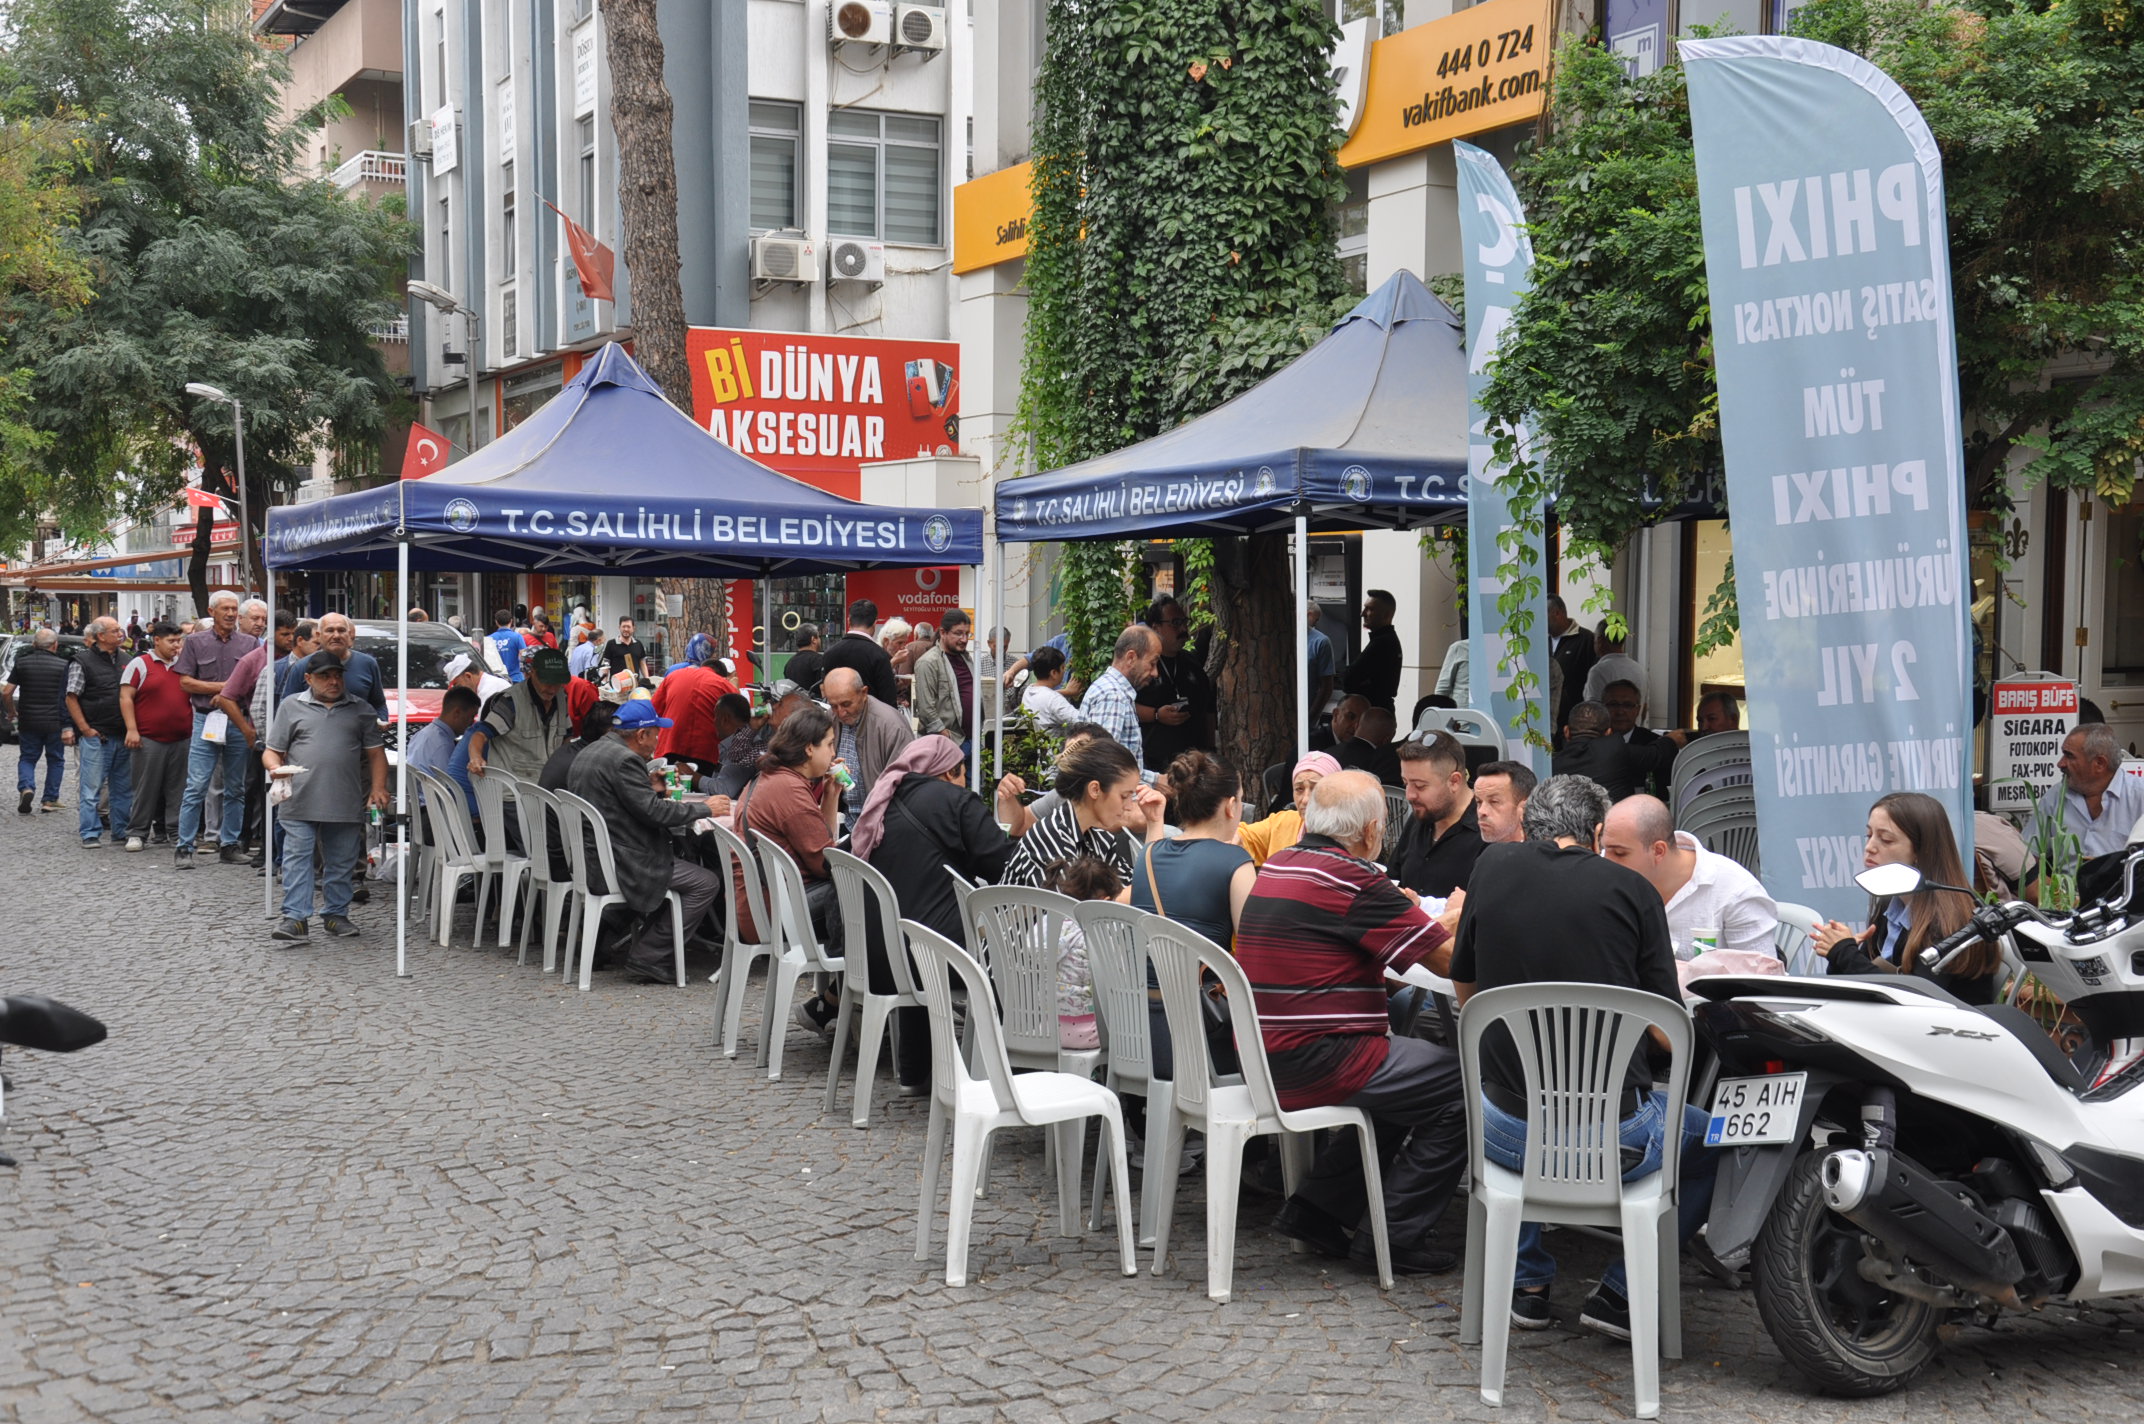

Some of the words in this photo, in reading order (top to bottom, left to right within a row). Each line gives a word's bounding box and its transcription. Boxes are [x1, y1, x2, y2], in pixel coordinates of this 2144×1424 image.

[1437, 45, 1473, 79] 444
[1478, 39, 1490, 68] 0
[1496, 24, 1534, 63] 724
[995, 217, 1026, 246] Salihli
[704, 336, 754, 404] Bİ
[760, 345, 884, 404] DÜNYA
[709, 408, 885, 459] AKSESUAR
[1130, 471, 1245, 516] BELEDİYESİ
[713, 513, 906, 550] BELEDİYESİ
[897, 591, 959, 605] vodafone
[1998, 689, 2038, 712] BARIŞ
[2041, 685, 2074, 708] BÜFE
[2009, 738, 2059, 757] FOTOKOPİ
[2011, 762, 2055, 779] FAX-PVC
[1719, 1084, 1748, 1109] 45
[1757, 1081, 1798, 1107] AIH
[1710, 1133, 1720, 1142] TR
[1726, 1112, 1771, 1137] 662
